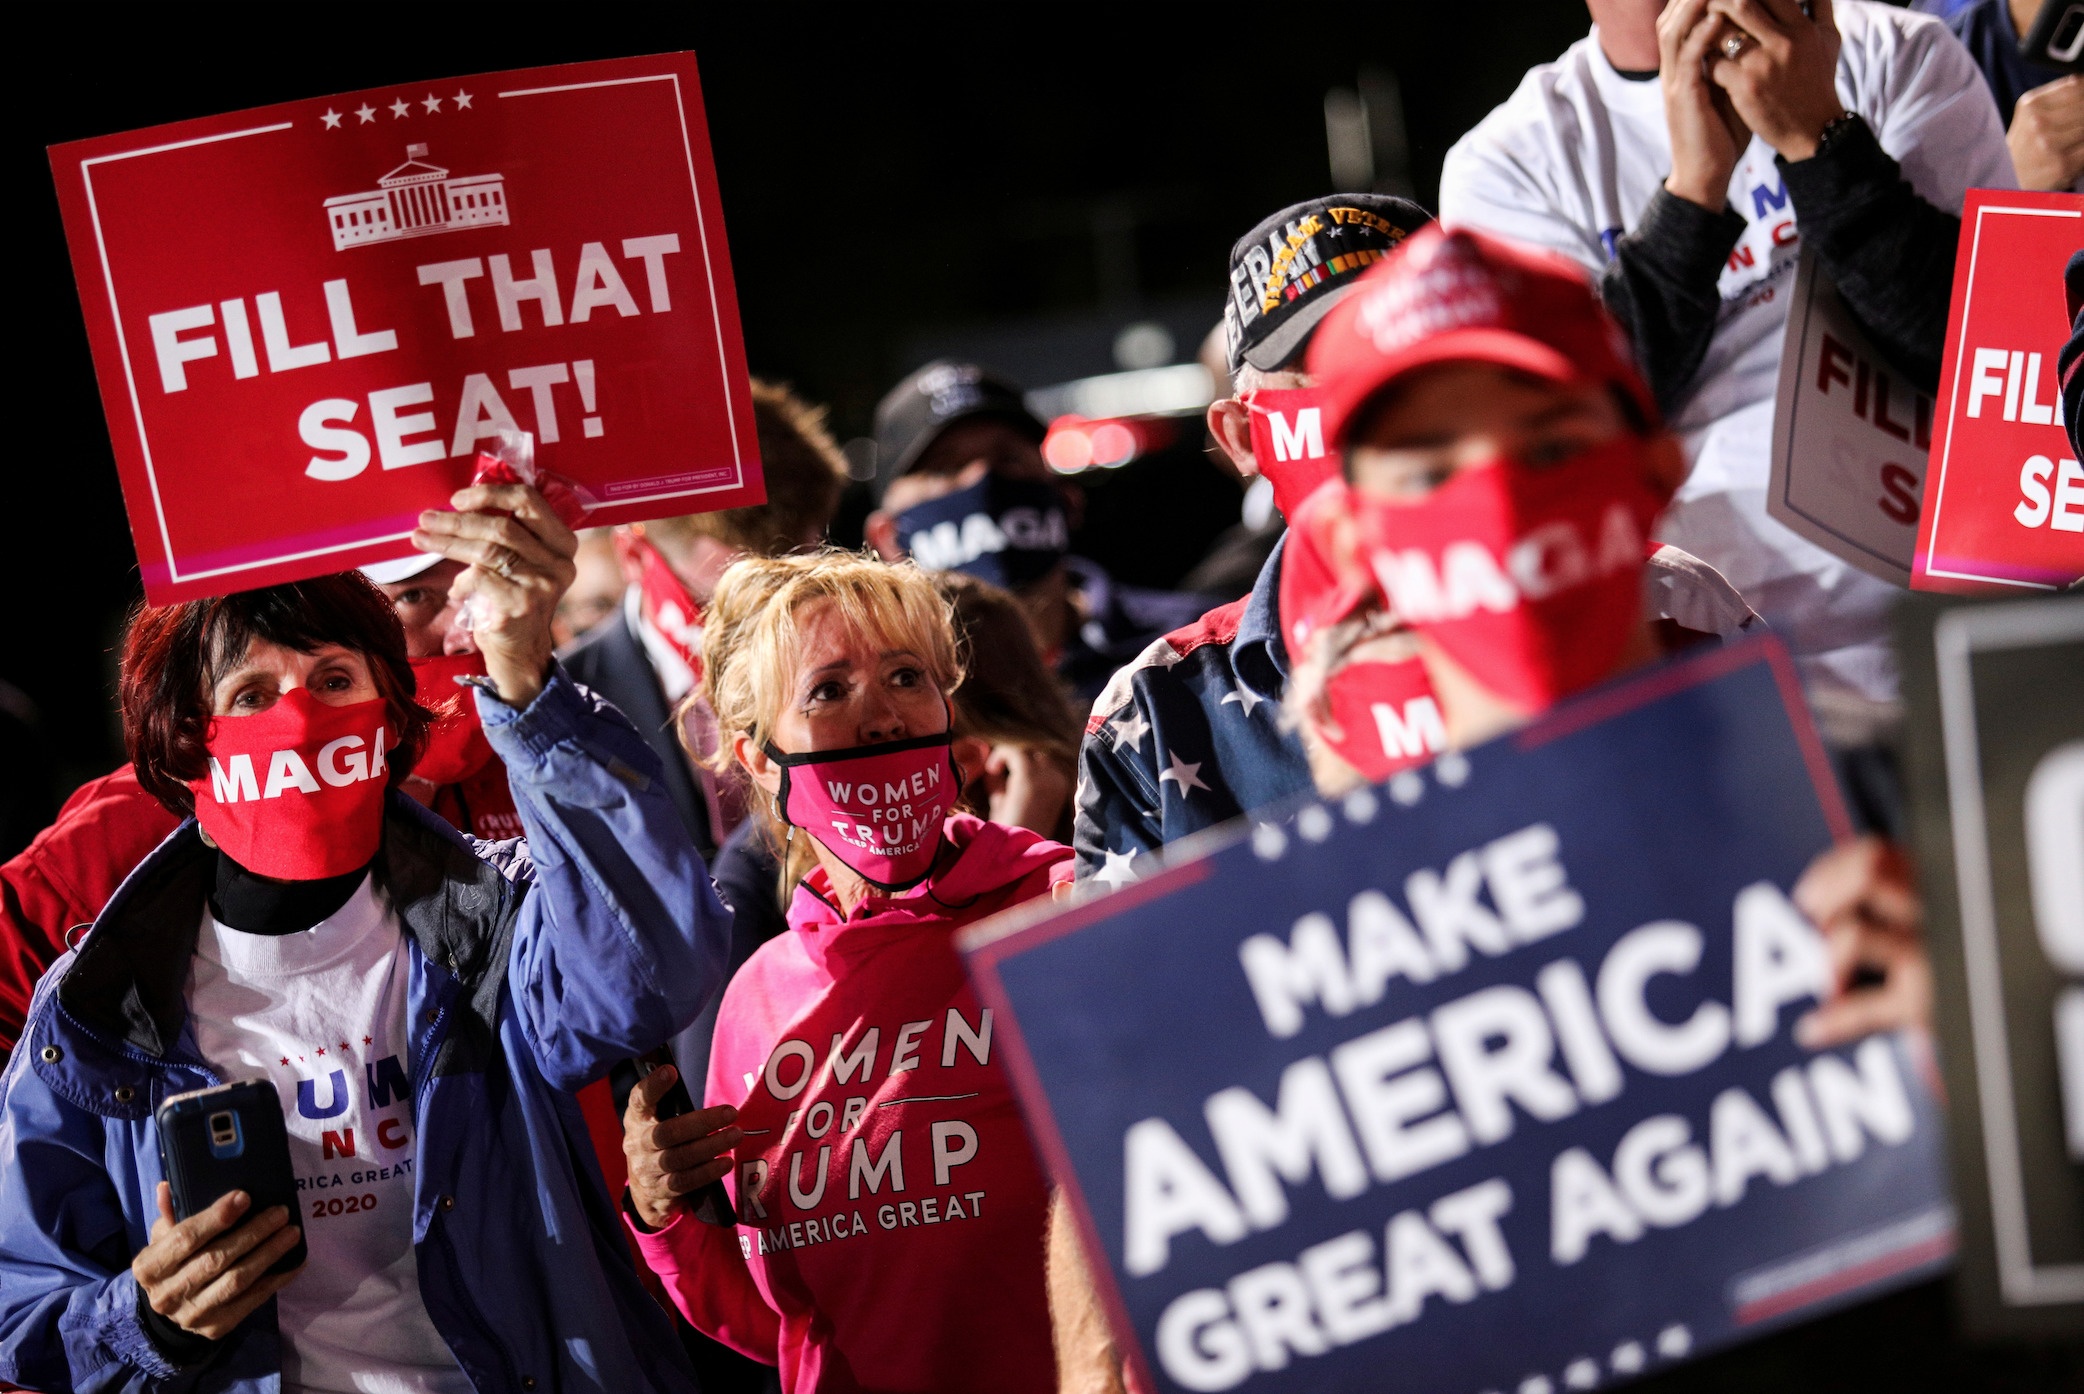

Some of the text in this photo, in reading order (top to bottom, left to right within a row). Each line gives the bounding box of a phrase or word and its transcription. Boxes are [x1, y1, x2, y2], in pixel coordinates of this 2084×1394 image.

[1328, 207, 1407, 241] VETER
[149, 233, 681, 394] FILL THAT
[298, 359, 605, 482] SEAT!
[1966, 347, 2066, 427] FIL
[2013, 454, 2084, 533] SE
[1371, 503, 1642, 623] MAGA
[828, 763, 940, 805] WOMEN
[872, 804, 913, 823] FOR
[831, 804, 941, 845] TRUMP
[1237, 821, 1586, 1039] MAKE
[1123, 879, 1834, 1277] AMERICA
[780, 1096, 868, 1146] FOR
[297, 1158, 413, 1192] RICA GREAT
[312, 1193, 378, 1219] 2020
[741, 1120, 979, 1223] RUMP
[757, 1211, 868, 1256] AMERICA
[878, 1191, 986, 1231] GREAT
[1155, 1177, 1518, 1392] GREAT
[1549, 1035, 1917, 1266] AGAIN
